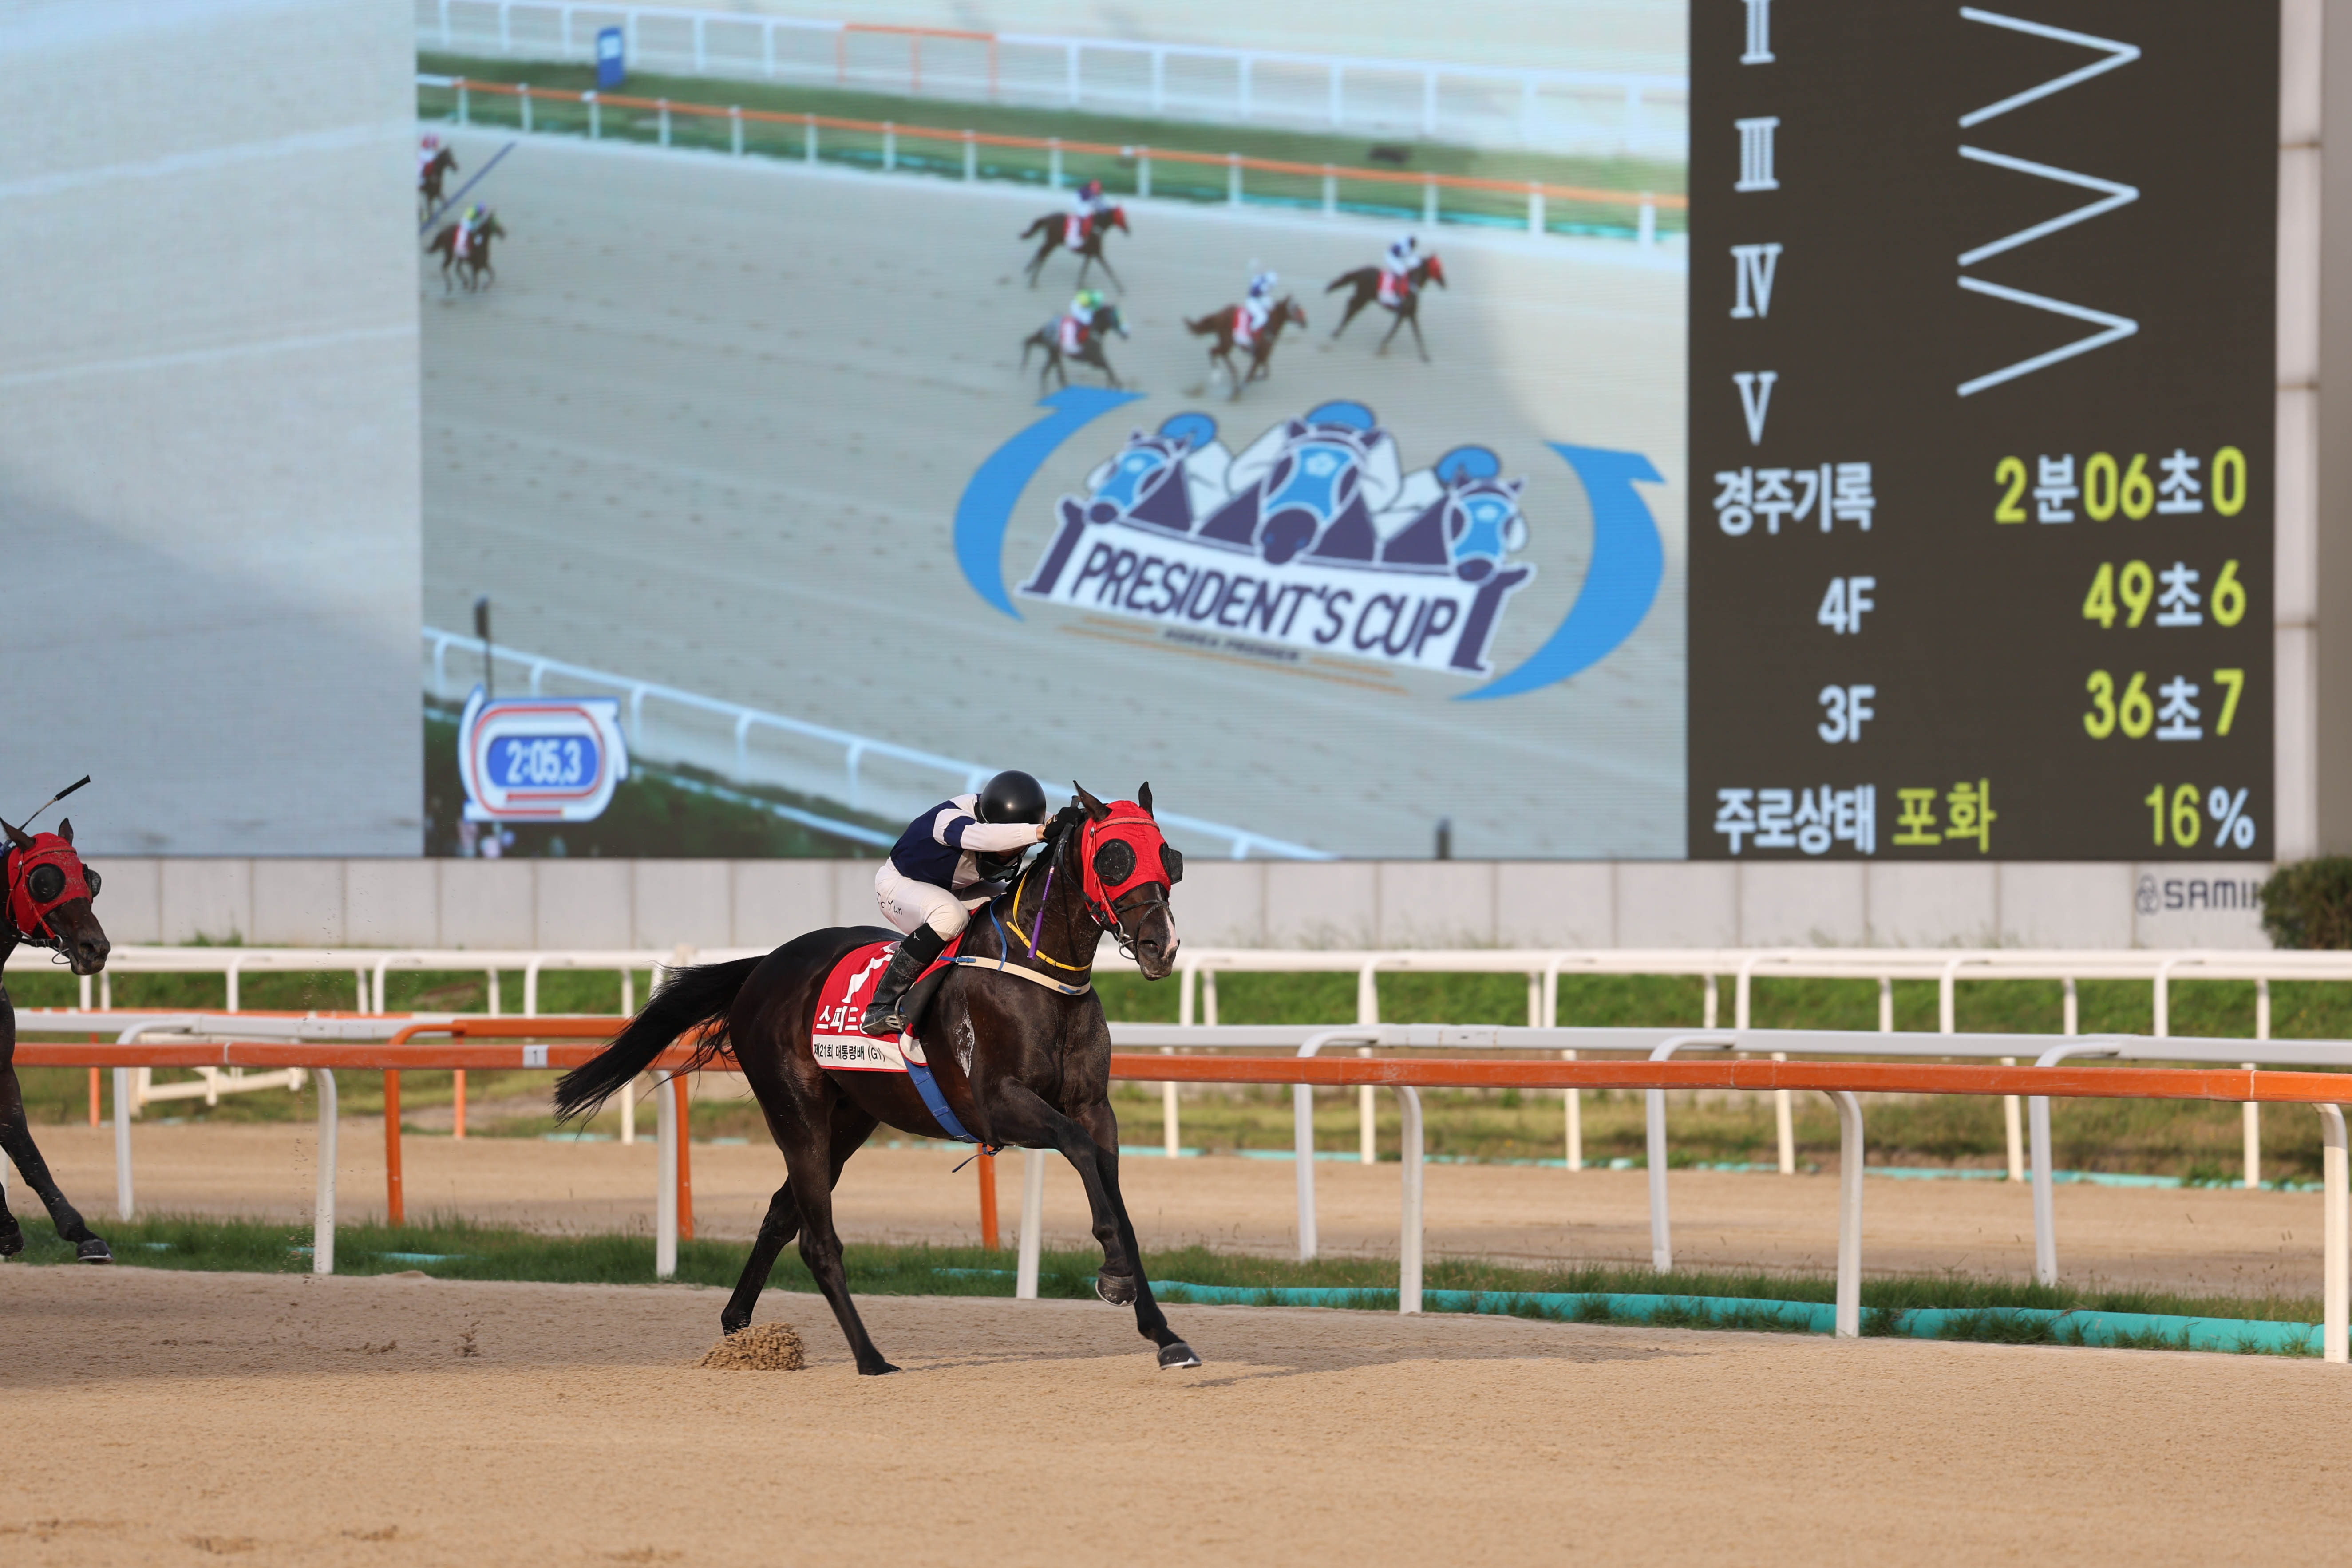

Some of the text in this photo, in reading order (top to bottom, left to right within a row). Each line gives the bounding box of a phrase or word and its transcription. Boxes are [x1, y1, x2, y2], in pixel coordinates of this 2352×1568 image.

[1733, 371, 1777, 444] V
[1713, 462, 1876, 536] 경주기록
[1071, 542, 1459, 657] PRESIDENT'S CUP
[1818, 576, 1876, 634] 4F
[1818, 685, 1876, 743] 3F
[1714, 785, 1876, 854] 주로상태
[1892, 779, 1997, 853] 포화
[814, 1043, 833, 1059] 제21회
[835, 1044, 865, 1061] 대통령배
[816, 1005, 868, 1035] 스피드
